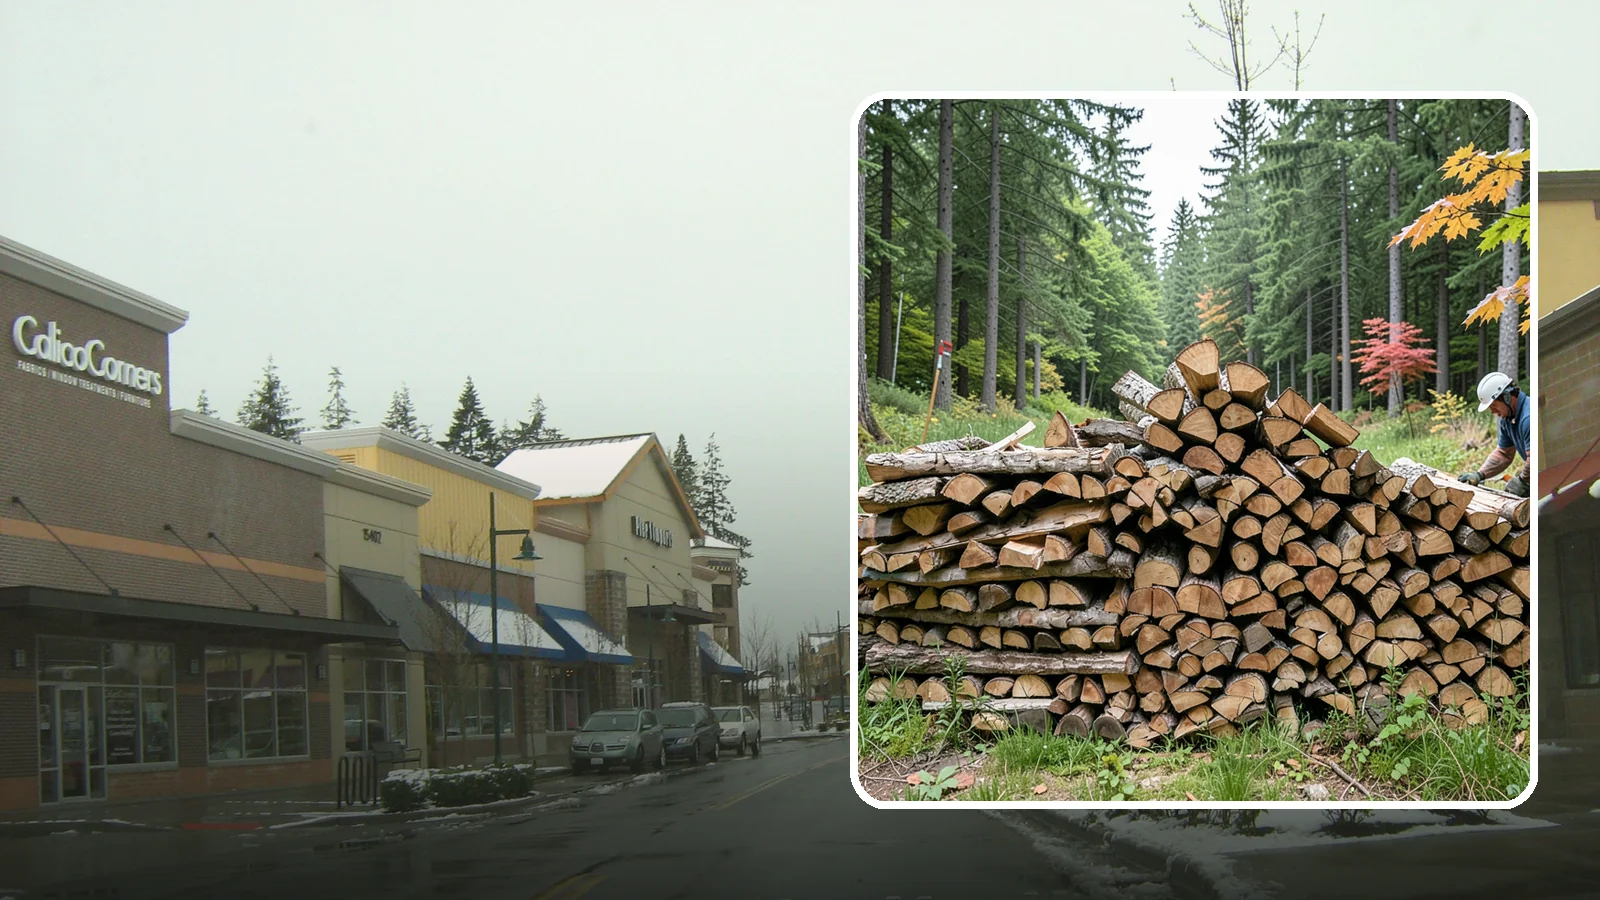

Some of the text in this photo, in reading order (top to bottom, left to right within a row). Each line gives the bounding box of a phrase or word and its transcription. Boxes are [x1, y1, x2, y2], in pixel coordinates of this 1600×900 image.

[17, 359, 47, 378] FABRICS
[51, 369, 78, 387] WINDOW
[78, 378, 117, 397] TREATMENTS
